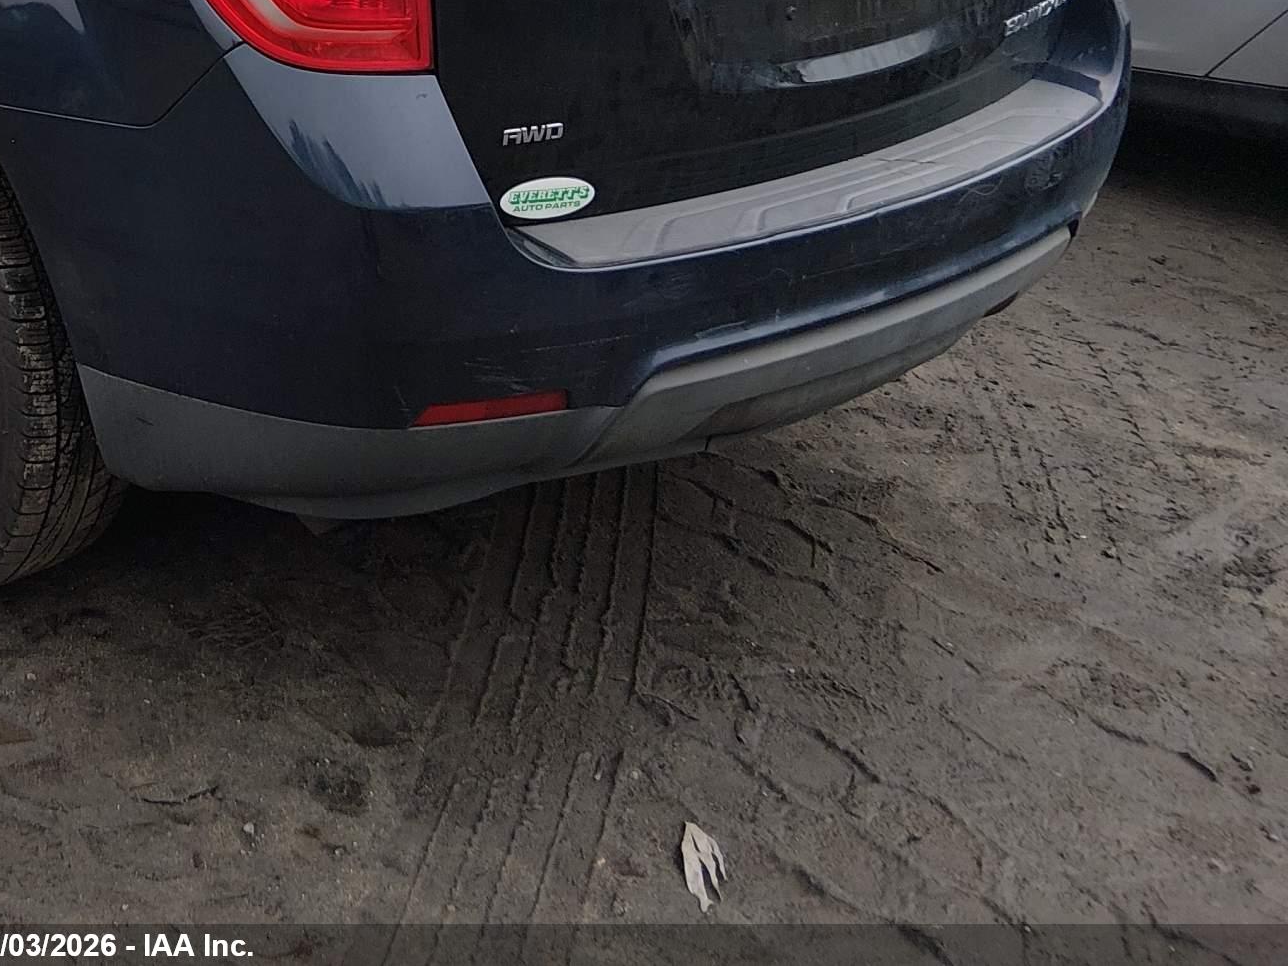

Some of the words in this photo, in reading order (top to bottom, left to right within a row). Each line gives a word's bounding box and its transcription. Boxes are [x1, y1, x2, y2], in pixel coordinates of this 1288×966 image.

[501, 122, 565, 147] AWD
[507, 185, 591, 206] EVERETT'S
[512, 203, 544, 213] AUTO
[544, 200, 582, 211] PARTS
